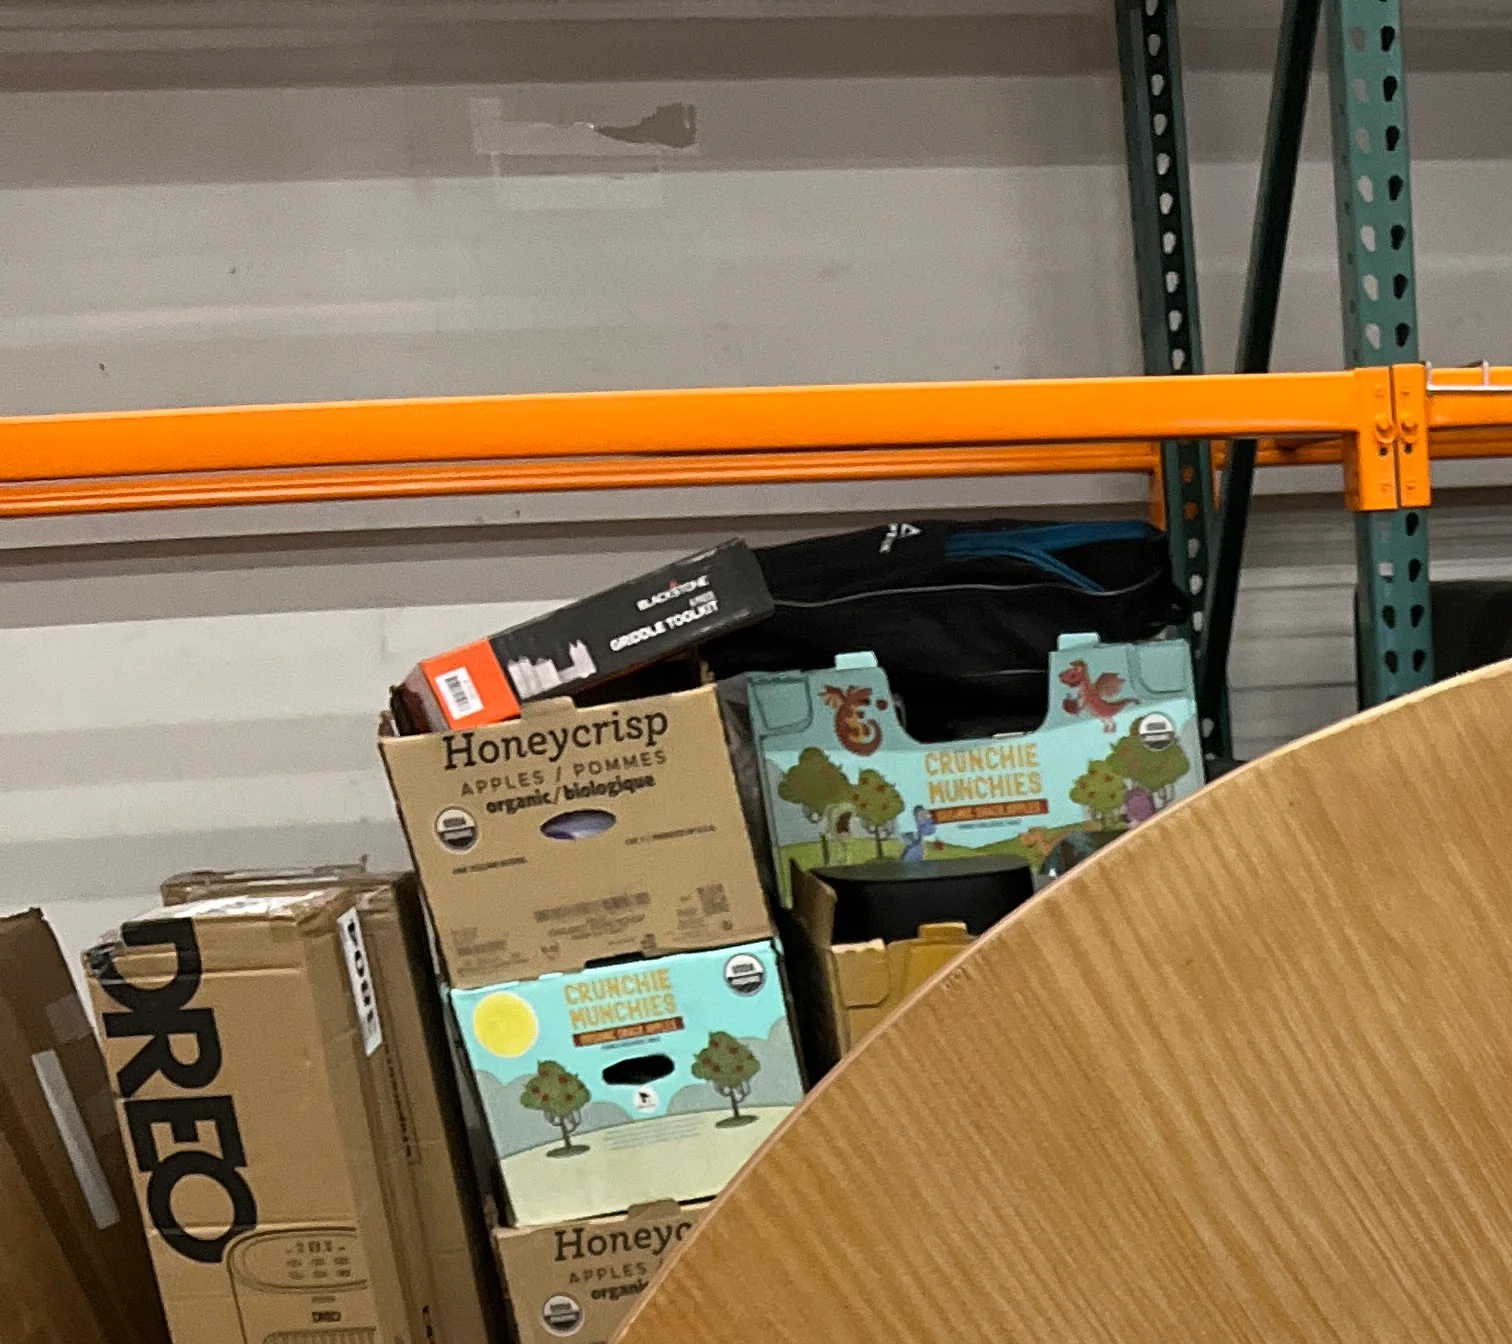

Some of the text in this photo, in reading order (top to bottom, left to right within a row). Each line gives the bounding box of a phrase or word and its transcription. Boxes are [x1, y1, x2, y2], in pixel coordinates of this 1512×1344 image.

[610, 600, 718, 651] GRIDDLE TOOLKIT
[442, 710, 669, 771] Honeycrisp
[460, 770, 545, 797] APPLES
[572, 750, 668, 778] POMMES
[924, 743, 1040, 777] CRUNCHIE
[928, 771, 1043, 804] MUNCHIES
[563, 967, 673, 1005] CRUNCHIE
[569, 993, 677, 1030] MUNCHIES
[89, 916, 258, 1264] DREO
[569, 1262, 647, 1284] APPLES
